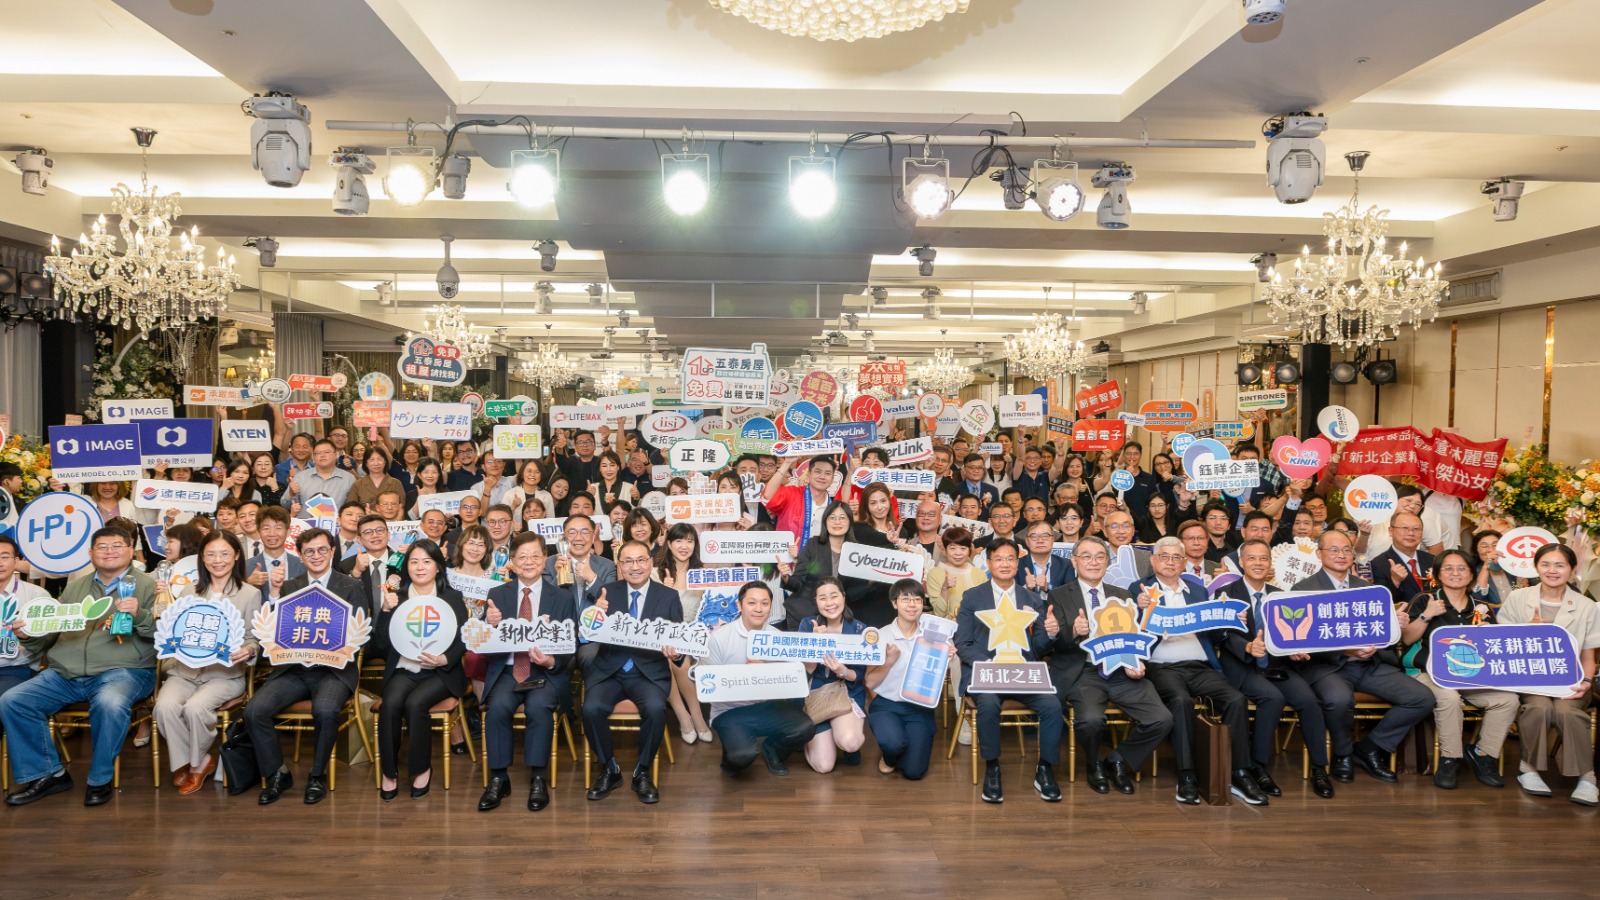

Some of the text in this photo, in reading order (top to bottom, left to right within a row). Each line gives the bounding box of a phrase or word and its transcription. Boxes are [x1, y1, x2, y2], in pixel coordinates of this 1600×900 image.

[437, 346, 457, 358] 免費
[413, 355, 452, 369] 五泰房屋
[715, 357, 765, 371] 五泰房屋
[858, 372, 904, 386] 夢想實現
[686, 379, 723, 399] 免費
[723, 390, 765, 401] 出租管理
[1239, 392, 1286, 402] SINTRONES
[130, 406, 169, 416] IMAGE
[613, 401, 647, 410] HULANE
[416, 414, 469, 425] 仁大資訊
[569, 413, 602, 421] LITEMAX
[659, 416, 677, 429] iisi
[786, 408, 822, 432] 遠百
[227, 428, 266, 439] ATEN
[443, 428, 468, 438] 7767
[828, 427, 865, 438] CyberLink
[1075, 429, 1122, 441] 鑫創電子
[86, 439, 134, 452] IMAGE
[791, 438, 841, 451] 遠東百貨
[887, 441, 924, 457] erLink
[680, 448, 716, 463] 正隆
[1289, 457, 1320, 467] KINIK
[57, 471, 80, 479] IMAGE
[1199, 461, 1258, 476] 鈺祥企業
[875, 470, 933, 485] 遠東百貨
[1186, 478, 1260, 491] 最得力的ESG夥伴
[160, 488, 214, 501] 遠東百貨
[1371, 491, 1390, 501] 中砂
[1360, 500, 1393, 510] KINIK
[720, 541, 790, 549] 正隆股份有限公司
[848, 551, 909, 573] CyberLink
[1287, 556, 1317, 576] 榮耀
[687, 567, 760, 584] 經濟發展局
[293, 605, 332, 625] 精典
[1317, 599, 1385, 619] 創新領航
[30, 618, 85, 633] 低碳未來
[184, 611, 221, 631] 典範
[1107, 612, 1124, 631] 1
[291, 625, 330, 646] 非凡
[499, 619, 566, 645] 新北企業
[610, 613, 708, 646] 新北市政府
[1318, 619, 1386, 640] 永續未來
[182, 629, 219, 651] 企業
[627, 638, 649, 648] Taipei
[772, 636, 837, 648] 與國際標準接軌
[1484, 635, 1564, 656] 深耕新北
[276, 651, 341, 663] NEW TAIPEI POWER
[1488, 657, 1569, 677] 放眼國際
[721, 674, 798, 689] Spirit Scientific
[979, 668, 1043, 684] 新北之星
